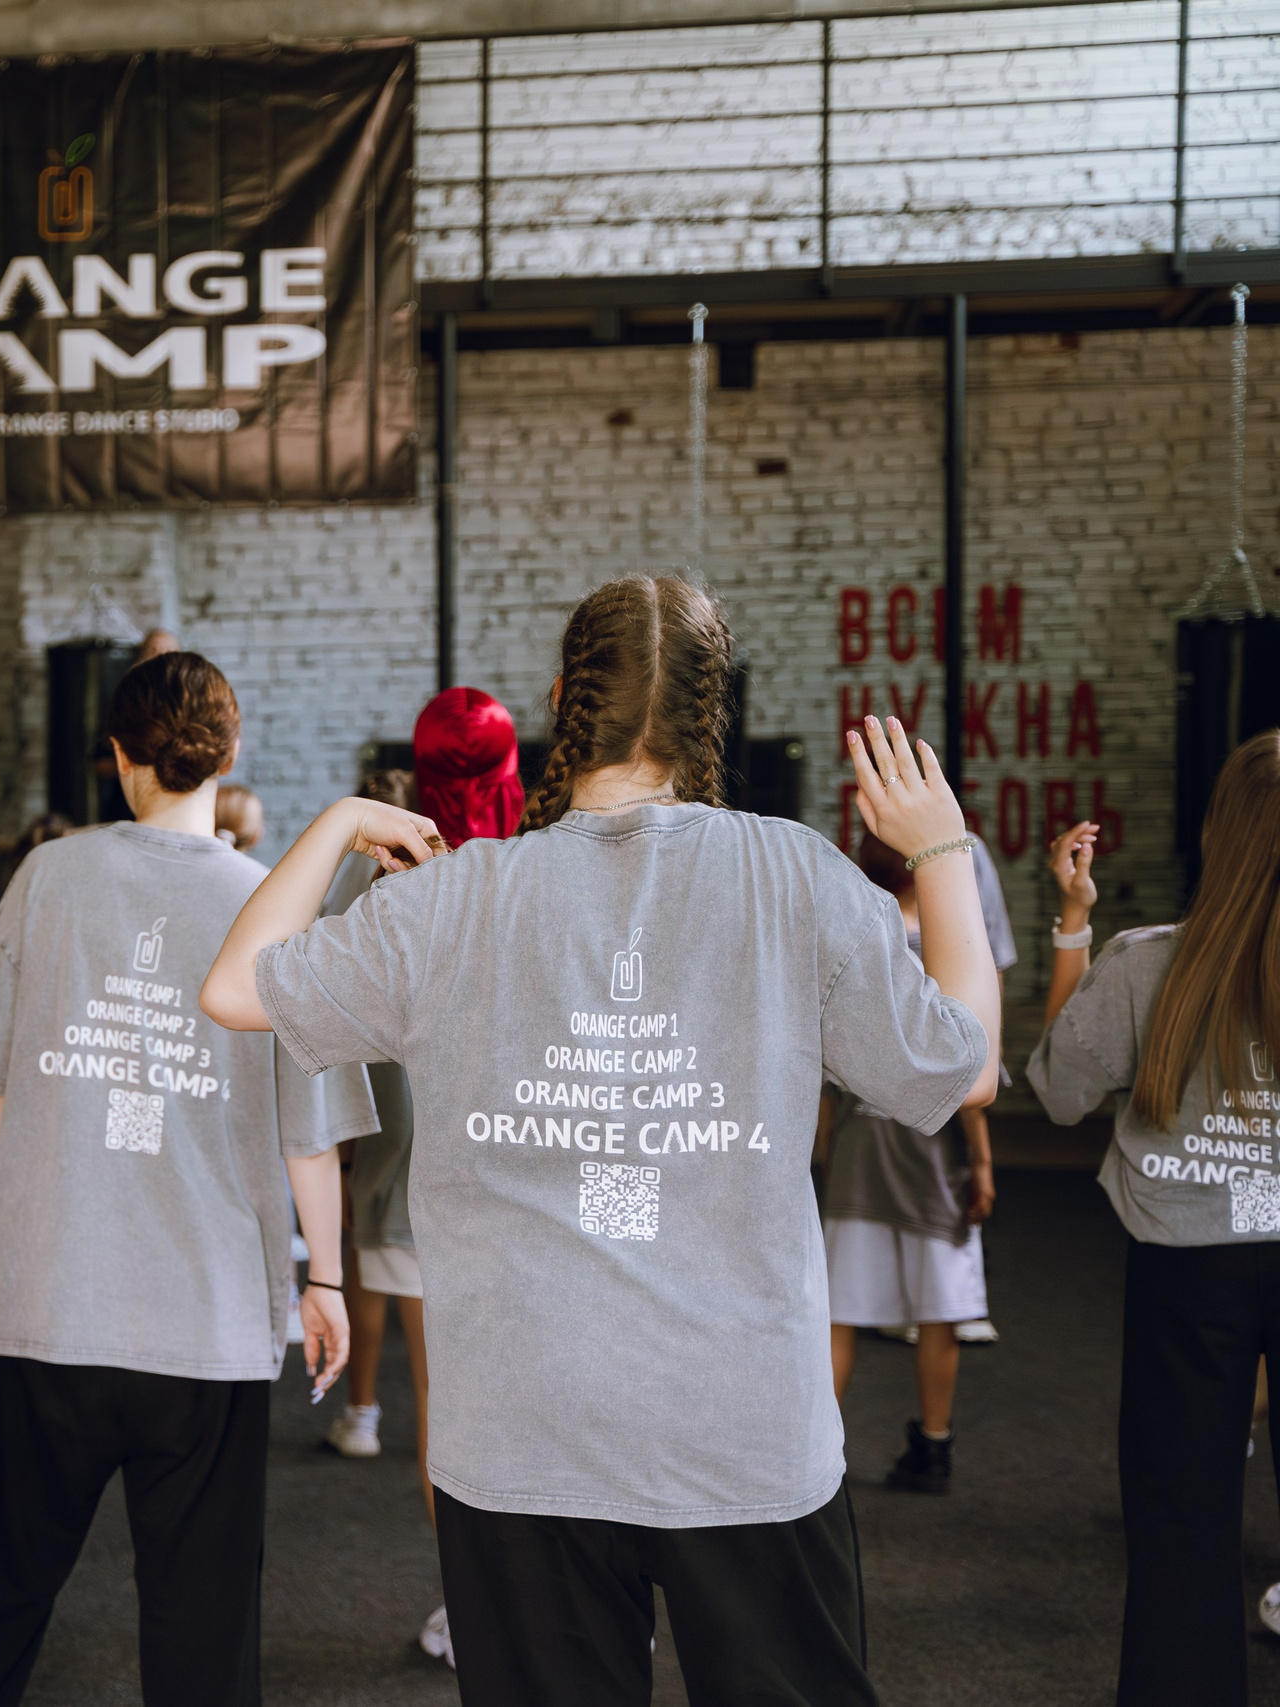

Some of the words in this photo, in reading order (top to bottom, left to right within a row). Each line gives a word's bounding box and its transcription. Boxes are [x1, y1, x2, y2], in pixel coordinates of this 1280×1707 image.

[73, 409, 152, 436] DANCE
[153, 407, 241, 435] STUDIO
[105, 974, 144, 1000] ORANGE
[143, 982, 175, 1006] CAMP
[174, 988, 183, 1008] 1
[86, 999, 142, 1026] ORANGE
[143, 1009, 184, 1035] CAMP
[184, 1017, 196, 1038] 2
[570, 1011, 626, 1039] ORANGE
[629, 1013, 667, 1039] CAMP
[670, 1013, 679, 1037] 1
[64, 1024, 142, 1054] ORANGE
[145, 1036, 196, 1064] CAMP
[198, 1048, 212, 1069] 3
[545, 1045, 625, 1073] ORANGE
[631, 1049, 683, 1074] CAMP
[686, 1046, 697, 1070] 2
[38, 1050, 141, 1085] ORANGE
[147, 1062, 219, 1100] CAMP
[515, 1079, 625, 1111] ORANGE
[632, 1082, 702, 1110] CAMP
[710, 1082, 725, 1108] 3
[466, 1111, 626, 1155] ORANGE
[638, 1120, 740, 1155] CAMP
[747, 1122, 771, 1154] 4
[1202, 1113, 1272, 1138] ORANGE
[1183, 1133, 1273, 1165] ORANGE
